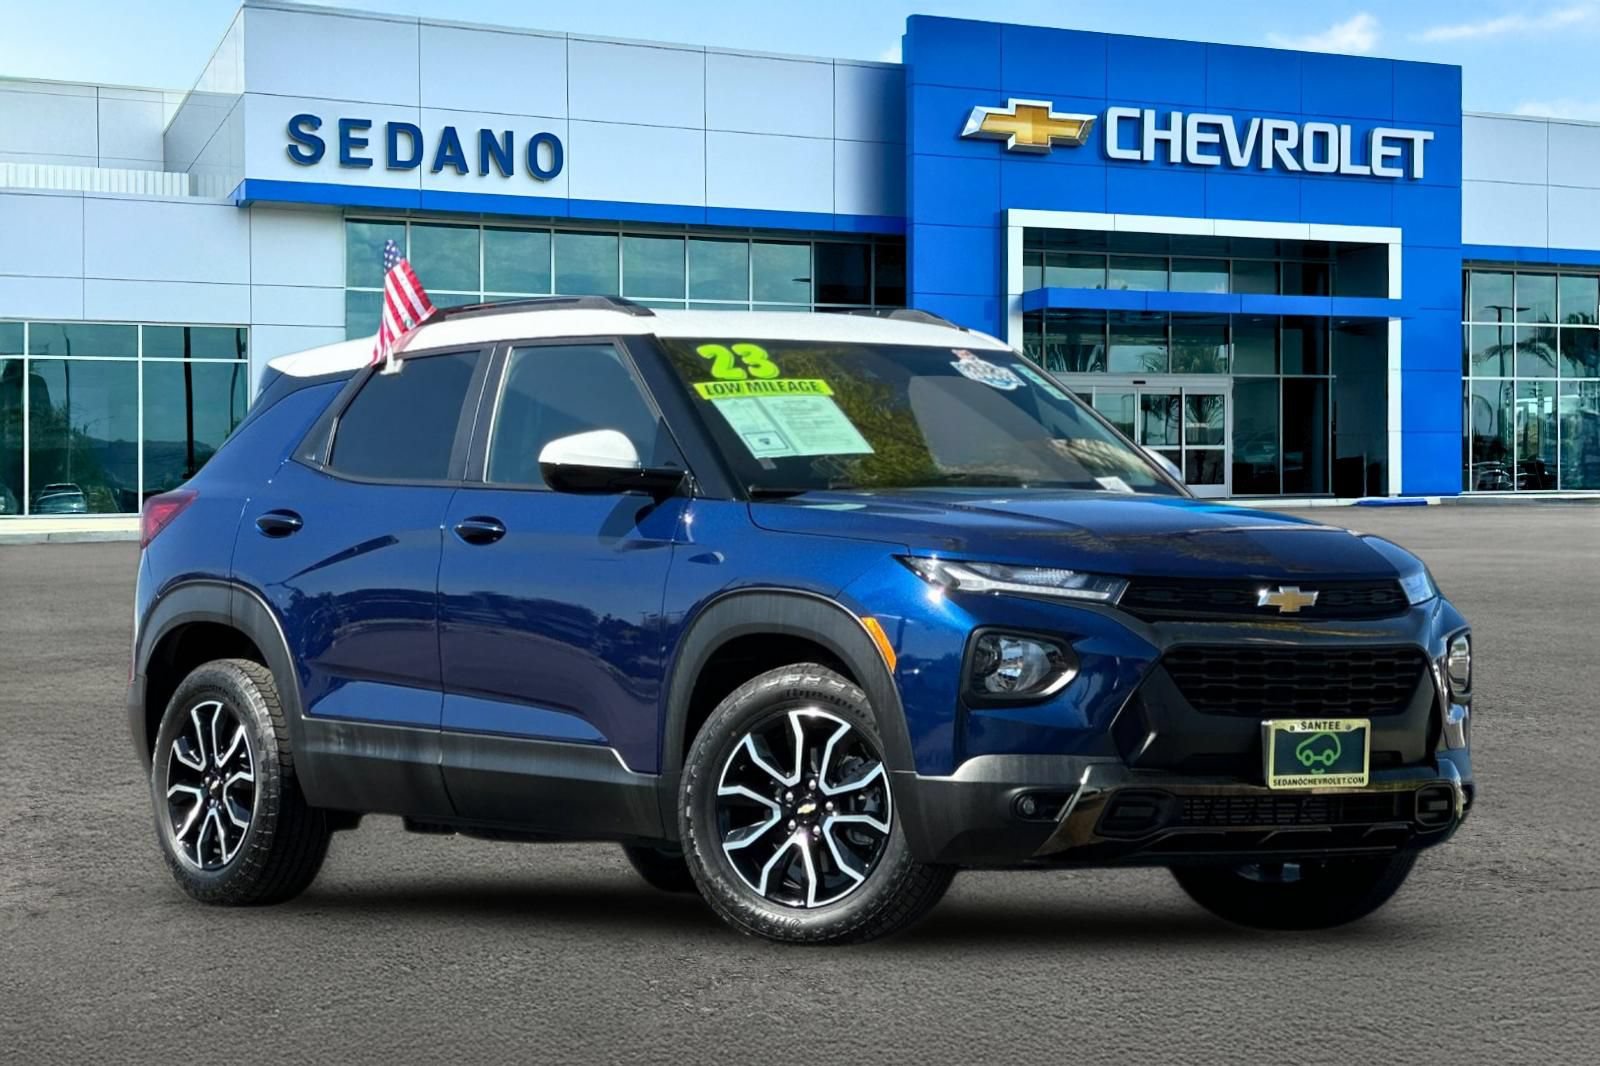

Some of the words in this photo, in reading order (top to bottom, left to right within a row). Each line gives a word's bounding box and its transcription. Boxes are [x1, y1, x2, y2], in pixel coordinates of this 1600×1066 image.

[286, 113, 564, 182] SEDANO
[1105, 106, 1435, 179] CHEVROLET
[696, 344, 780, 380] 23
[704, 382, 741, 396] LOW
[746, 381, 820, 394] MILEAGE
[1301, 721, 1341, 730] SANTEE
[1273, 777, 1364, 787] SEDANOCHEVROLET.COM
